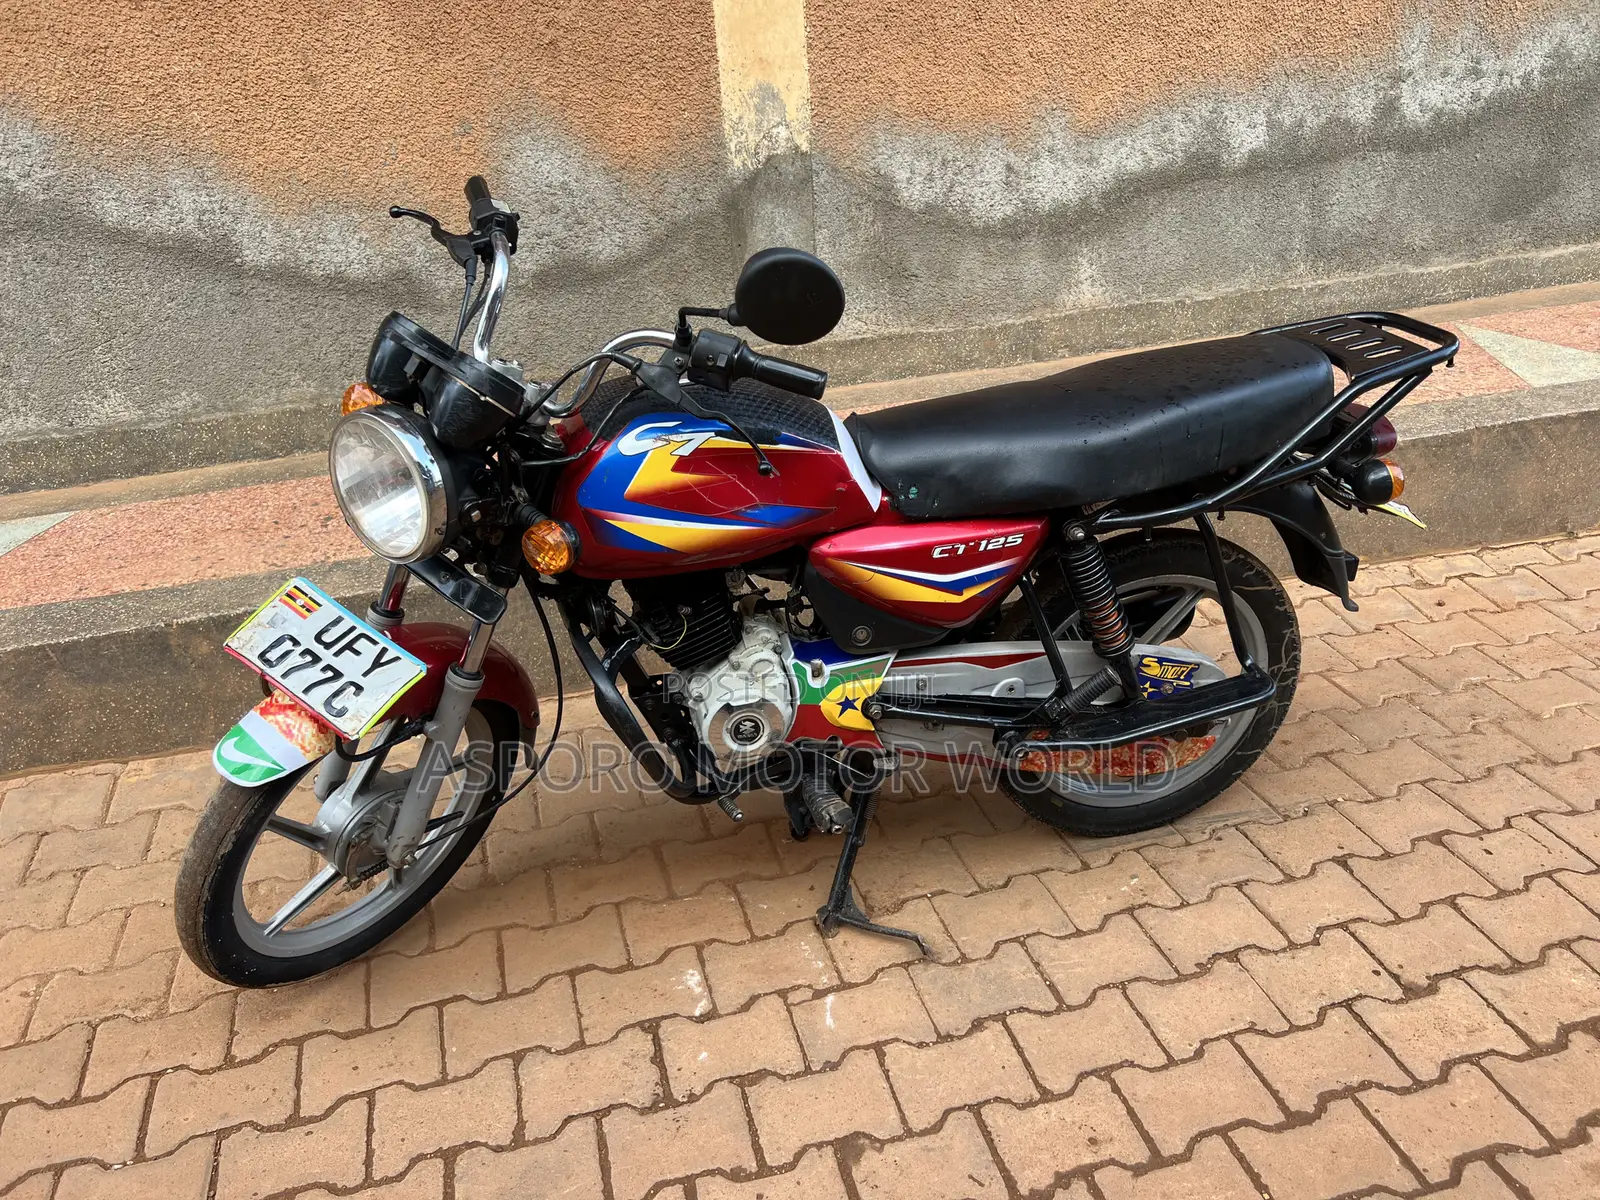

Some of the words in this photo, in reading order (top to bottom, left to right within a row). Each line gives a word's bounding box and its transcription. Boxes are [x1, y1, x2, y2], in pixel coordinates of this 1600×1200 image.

[617, 421, 716, 456] CT
[932, 543, 974, 559] CT
[978, 533, 1025, 552] 125
[313, 615, 402, 679] UFY
[257, 633, 364, 718] 077C
[1140, 657, 1199, 680] Smart
